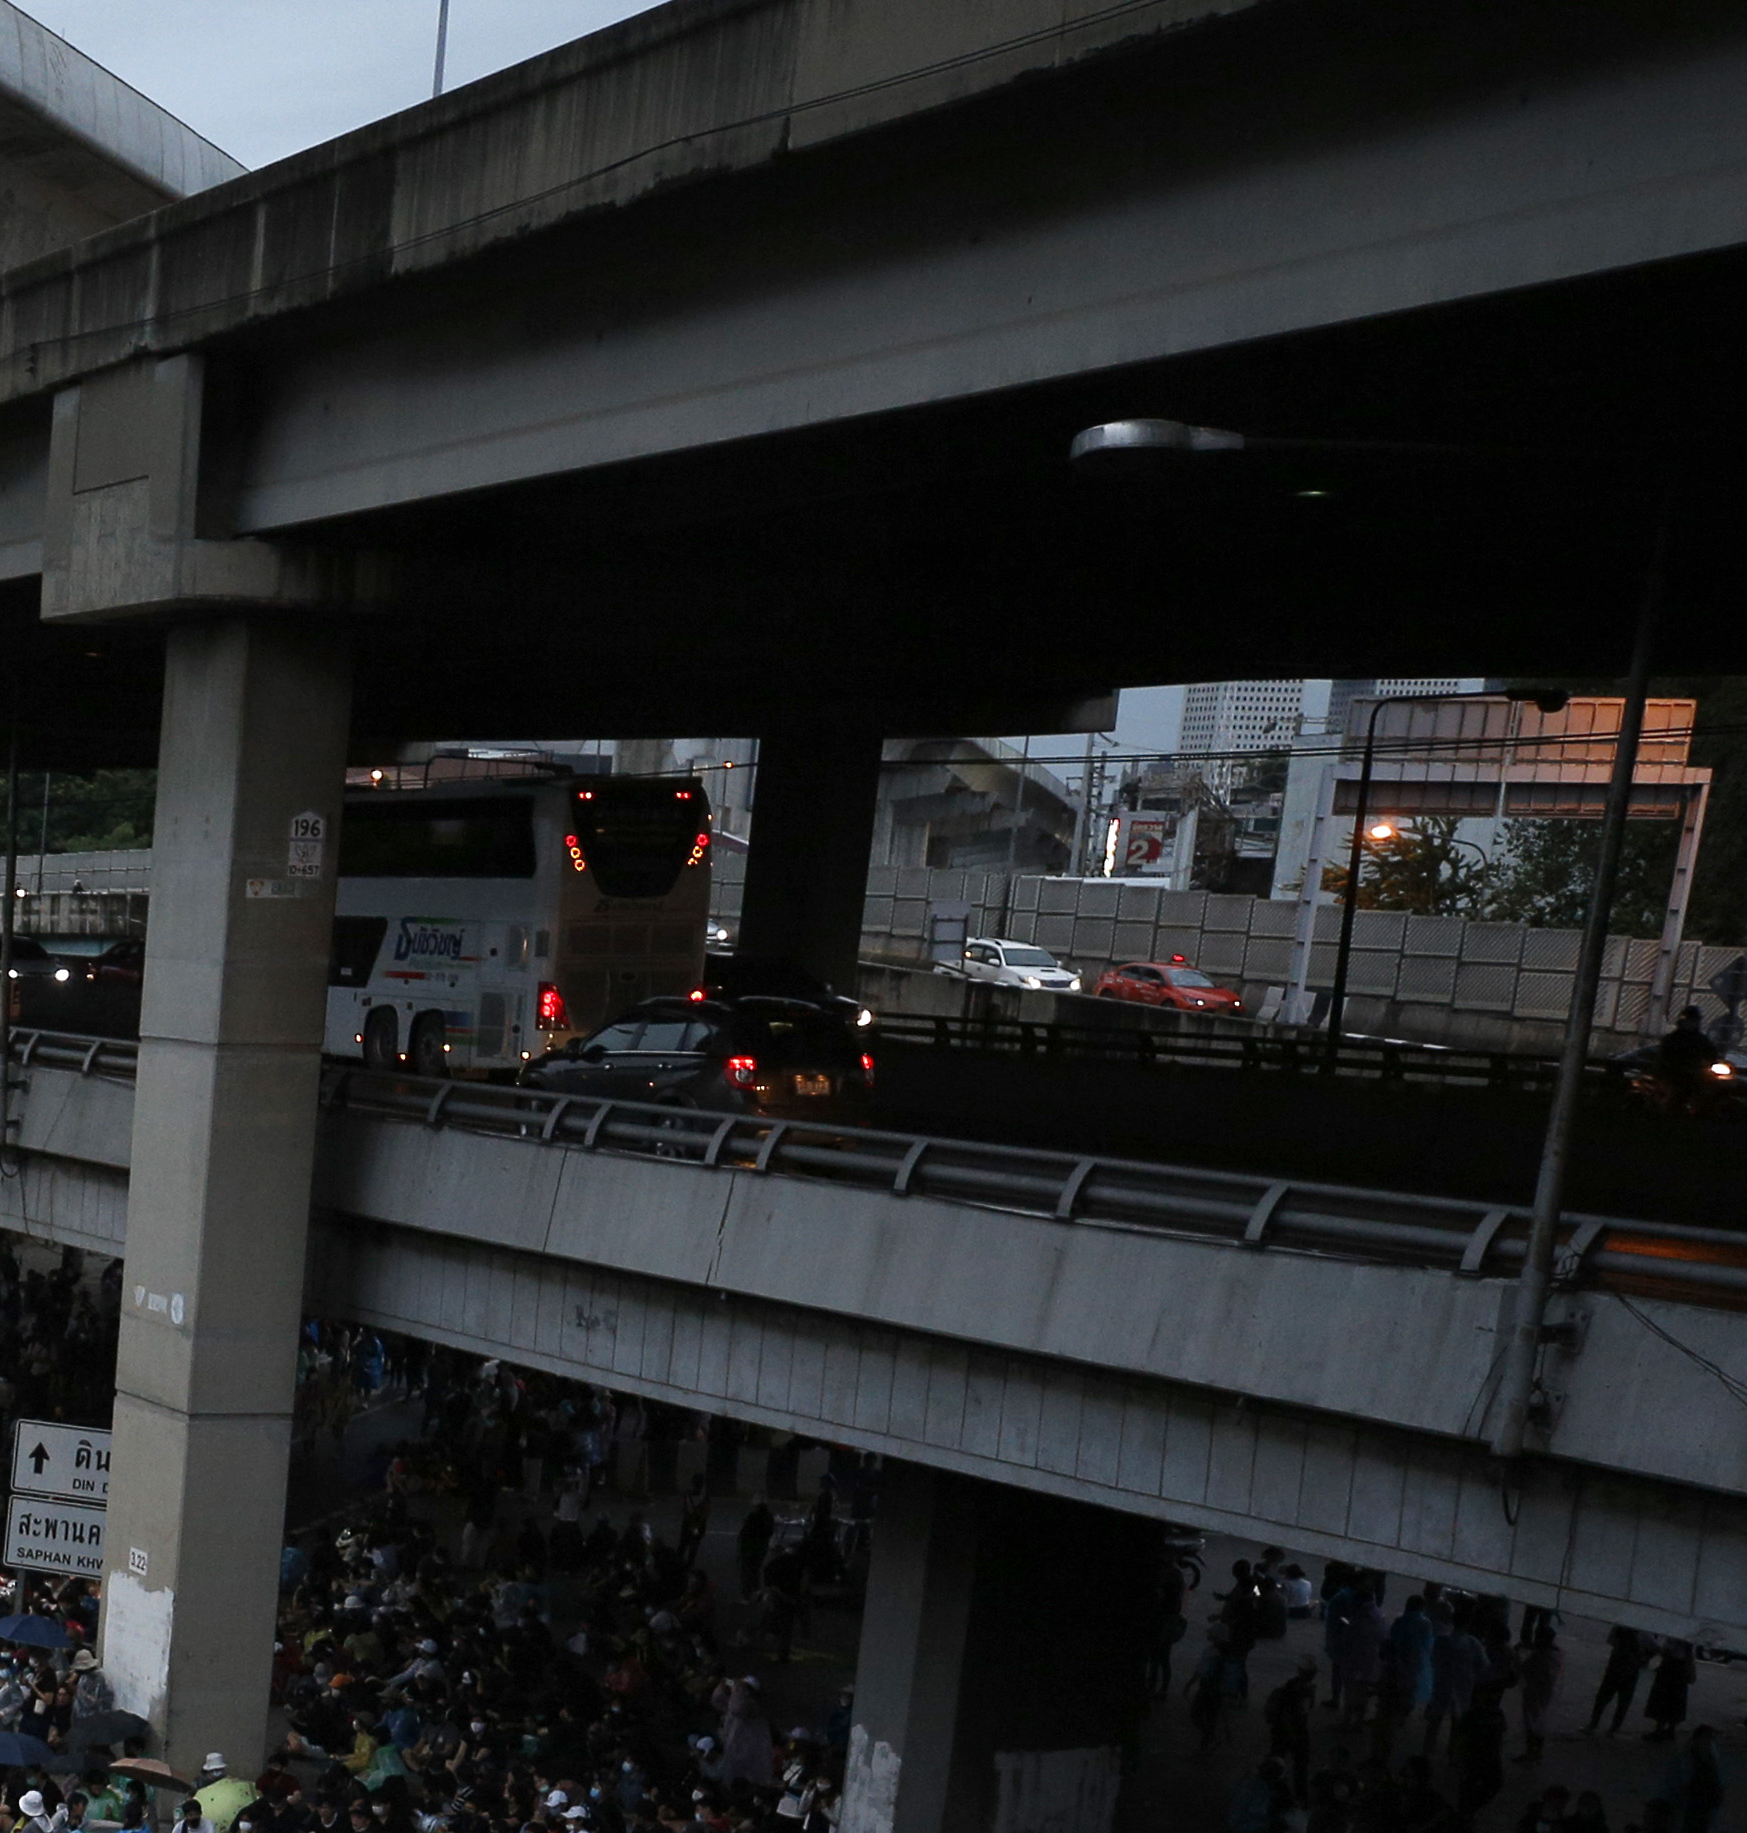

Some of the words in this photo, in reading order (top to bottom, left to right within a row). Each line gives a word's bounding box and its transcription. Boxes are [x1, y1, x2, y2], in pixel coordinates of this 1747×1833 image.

[294, 819, 321, 837] 196
[75, 1439, 112, 1473] ดิน
[72, 1478, 96, 1493] DIN
[18, 1513, 102, 1547] สะพานค
[16, 1546, 72, 1566] SAPHAN
